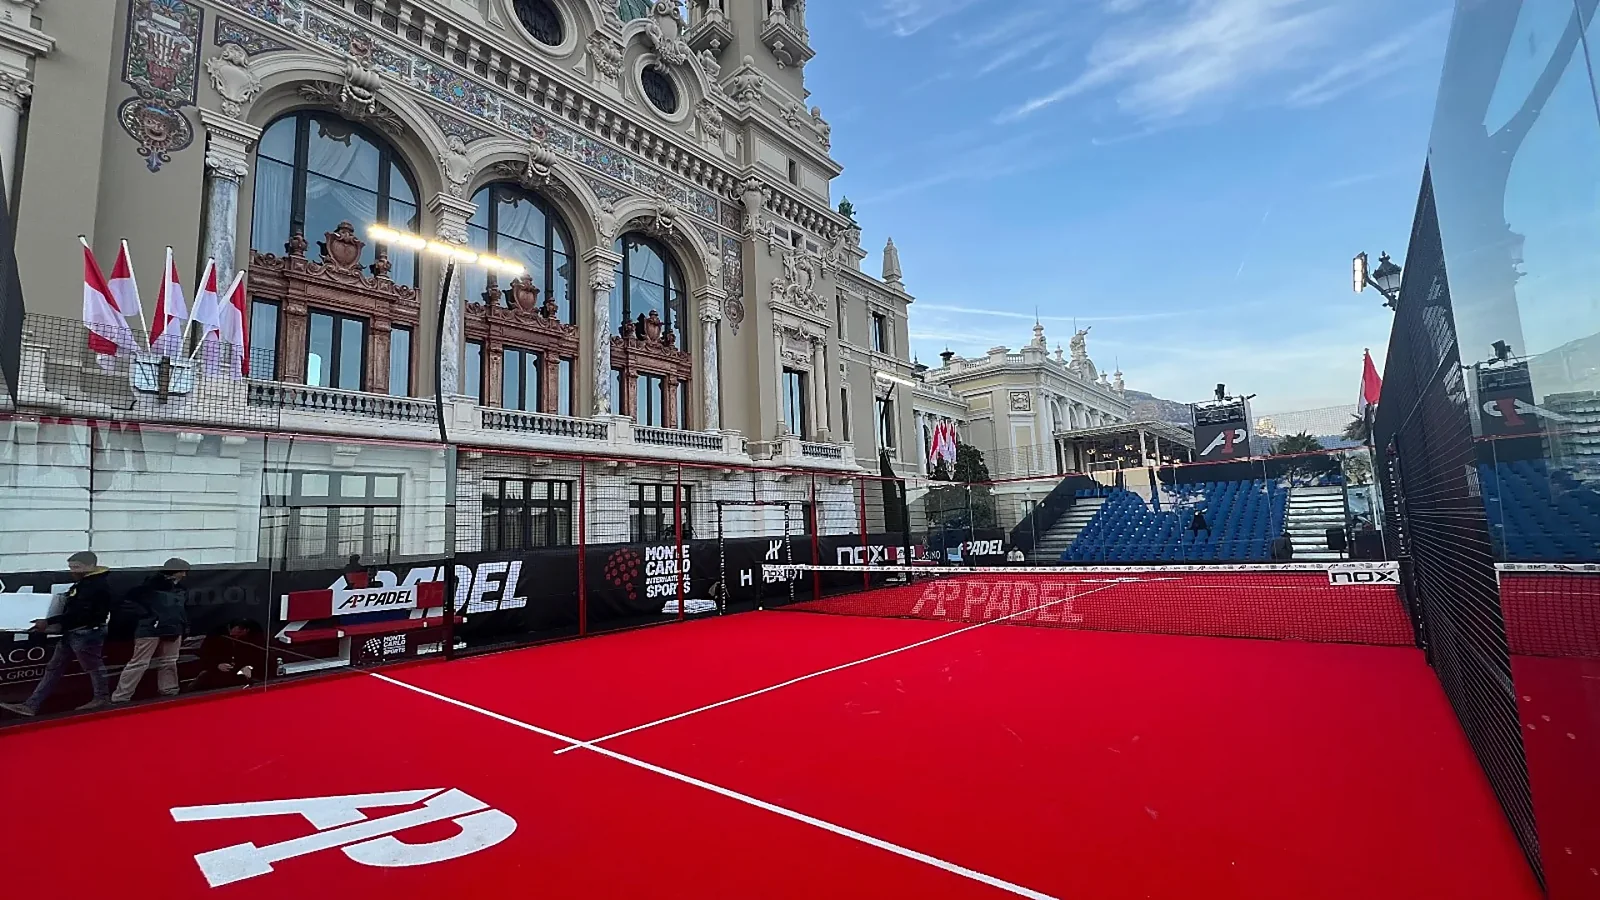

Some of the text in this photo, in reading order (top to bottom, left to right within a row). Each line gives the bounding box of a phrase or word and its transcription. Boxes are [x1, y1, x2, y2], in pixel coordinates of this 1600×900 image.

[645, 545, 690, 561] MONTE
[645, 559, 691, 576] CARLO
[645, 574, 691, 585] INTERNATIAL
[646, 581, 690, 598] SPORS
[364, 590, 412, 607] PADEL
[963, 580, 1083, 622] PADEL
[383, 634, 406, 642] MONTE
[383, 640, 406, 648] CARLO
[383, 647, 406, 655] SPORTS
[7, 668, 45, 680] GROU
